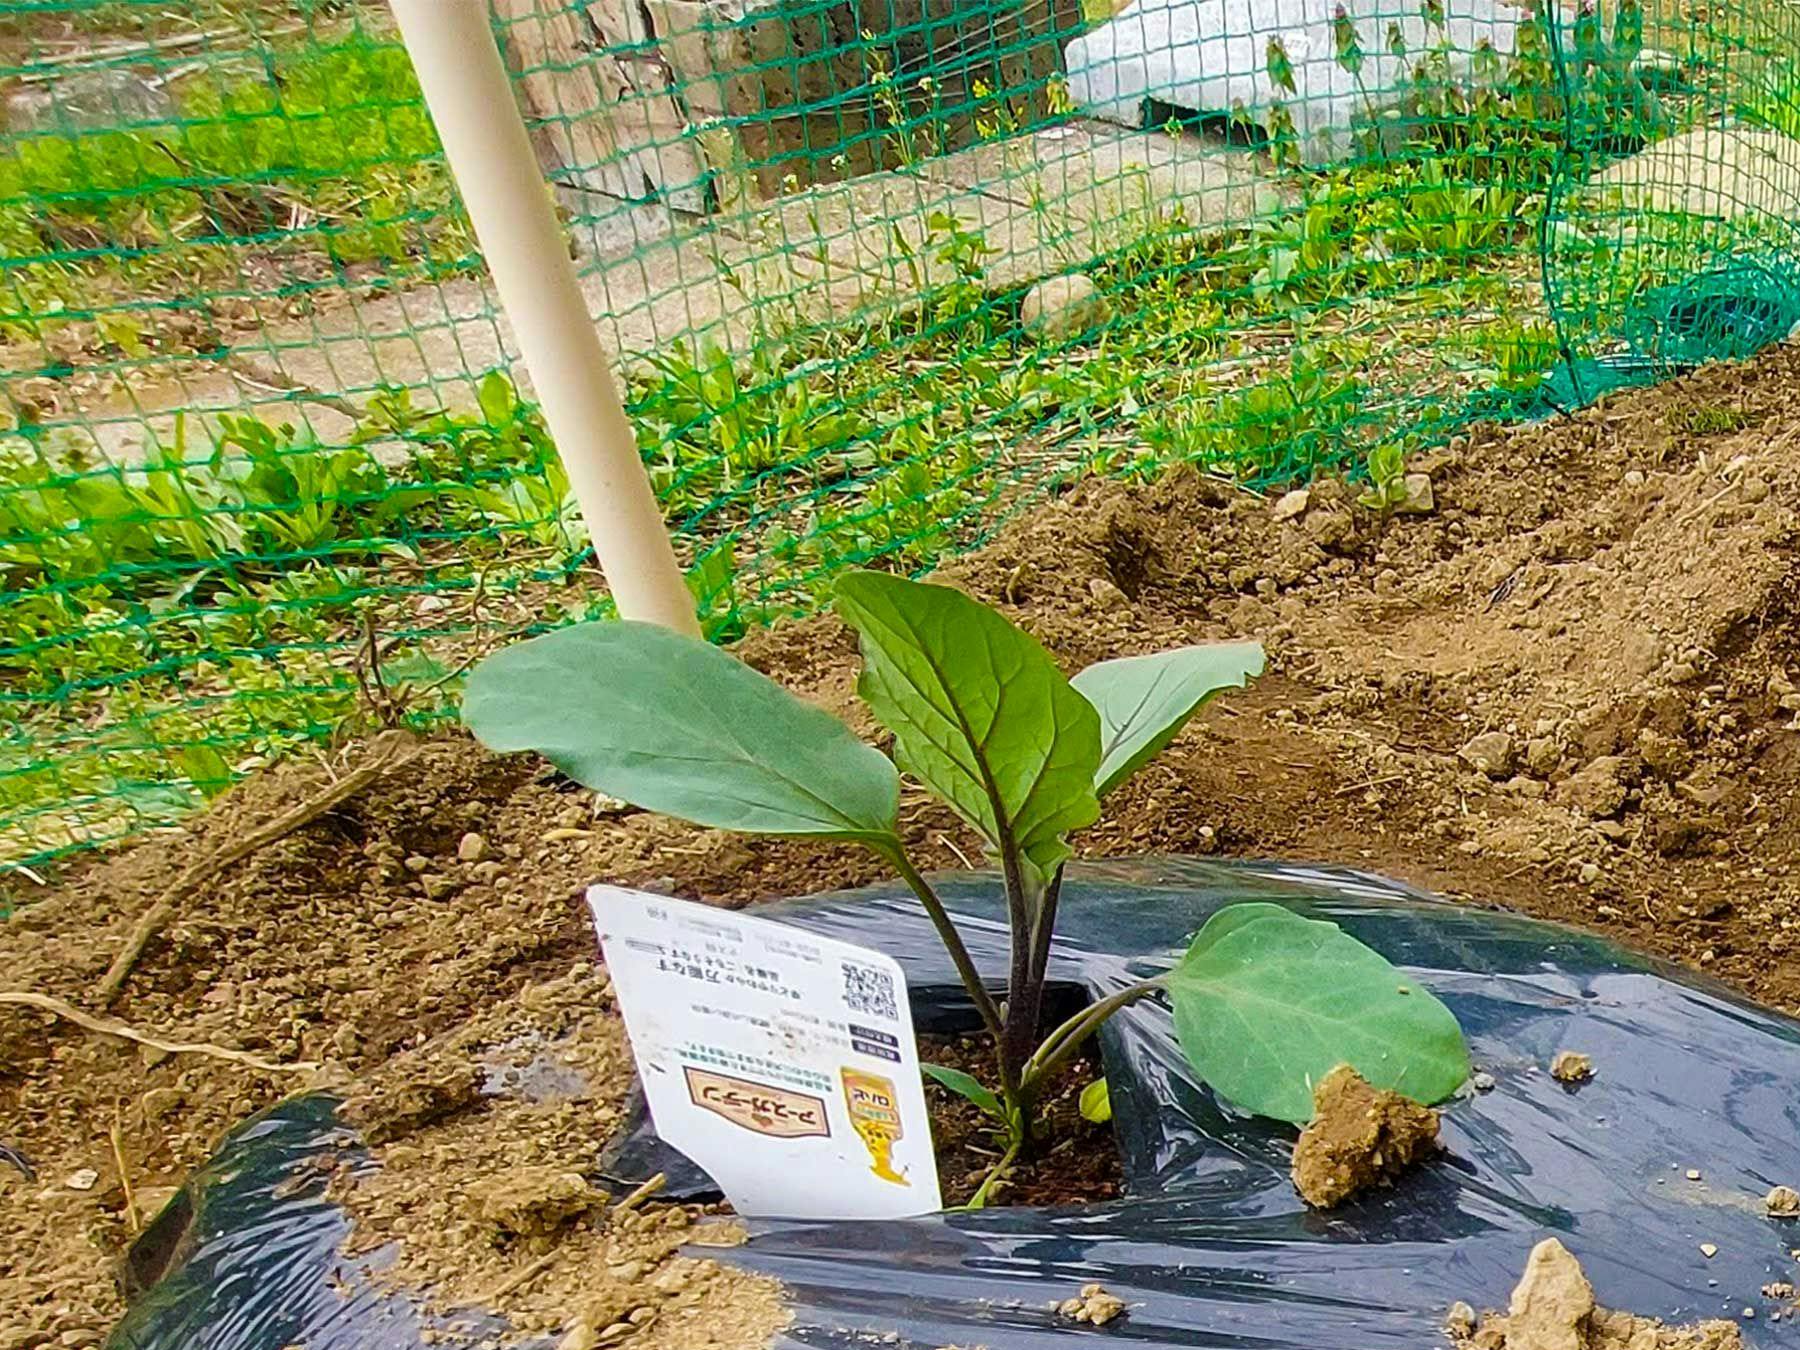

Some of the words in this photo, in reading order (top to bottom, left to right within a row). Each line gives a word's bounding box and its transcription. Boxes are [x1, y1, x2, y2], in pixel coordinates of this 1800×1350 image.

[656, 958, 721, 984] 万能なす
[702, 1086, 817, 1126] アースガーデン
